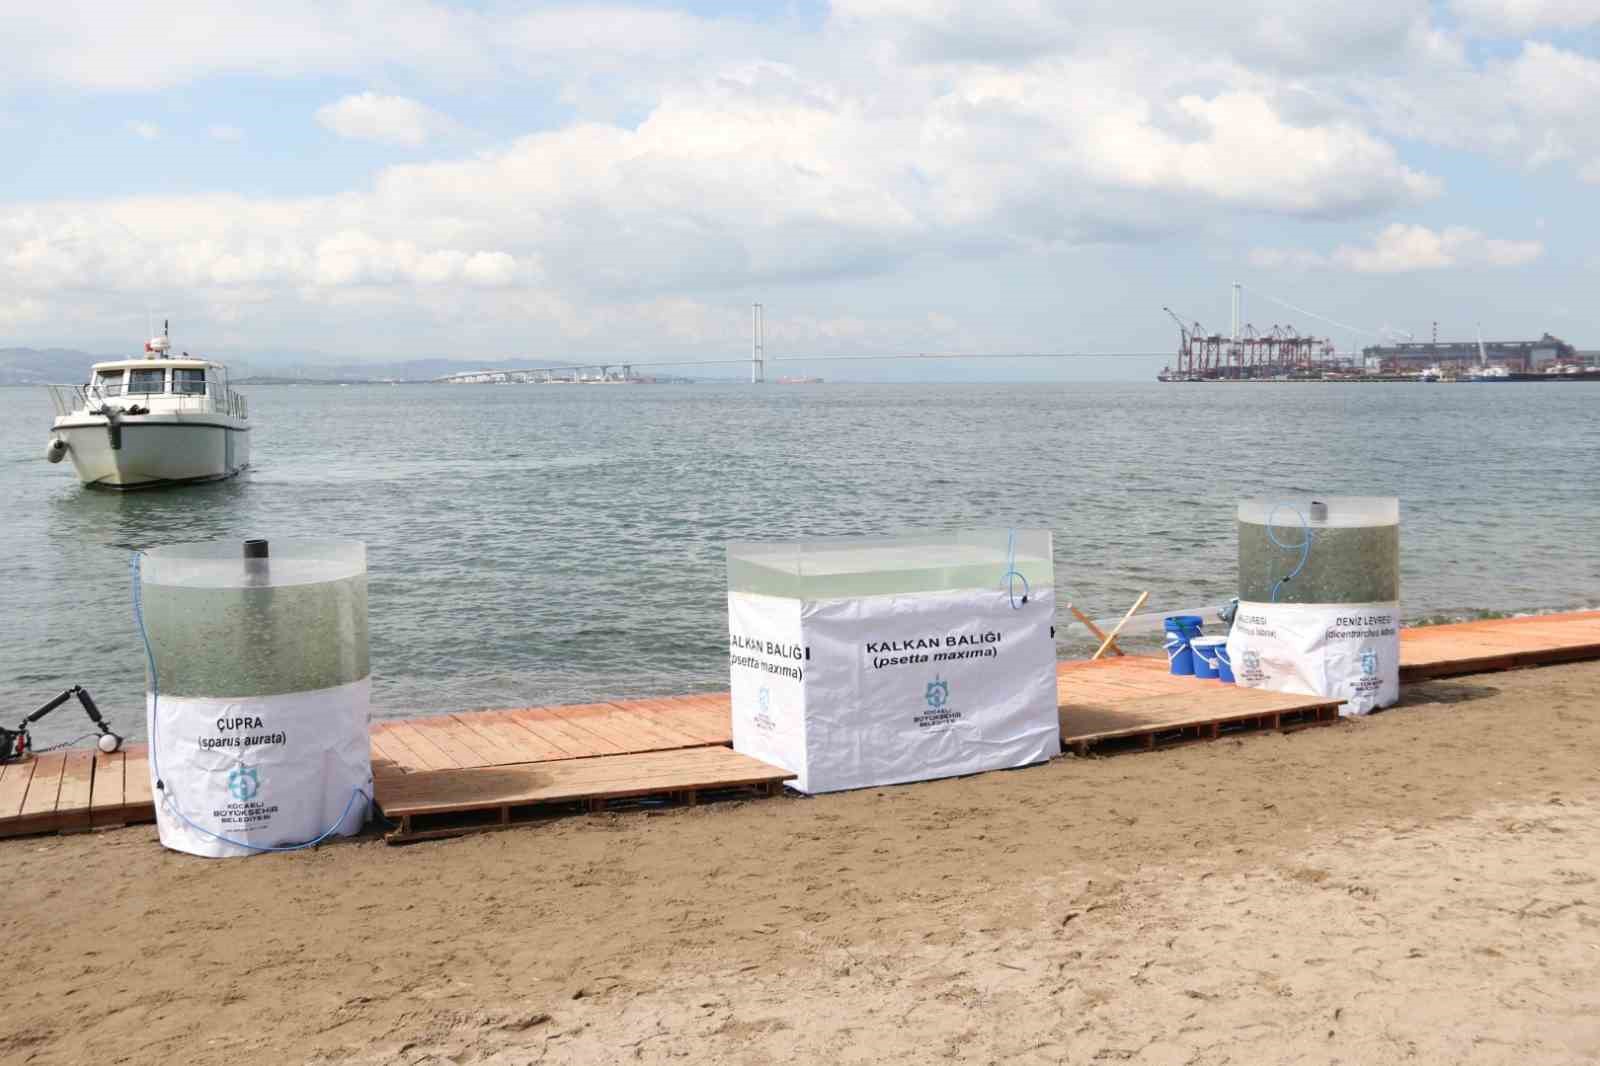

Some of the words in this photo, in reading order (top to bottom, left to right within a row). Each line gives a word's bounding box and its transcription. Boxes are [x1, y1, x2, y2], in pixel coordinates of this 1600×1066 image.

[729, 634, 763, 652] ALKAN
[866, 638, 940, 653] KALKAN
[946, 631, 1001, 647] BALIĞI
[729, 654, 759, 669] psetta
[873, 655, 929, 669] (psetta
[216, 716, 263, 732] ÇUPRA
[198, 735, 241, 750] (sparus
[244, 731, 286, 747] aurata)
